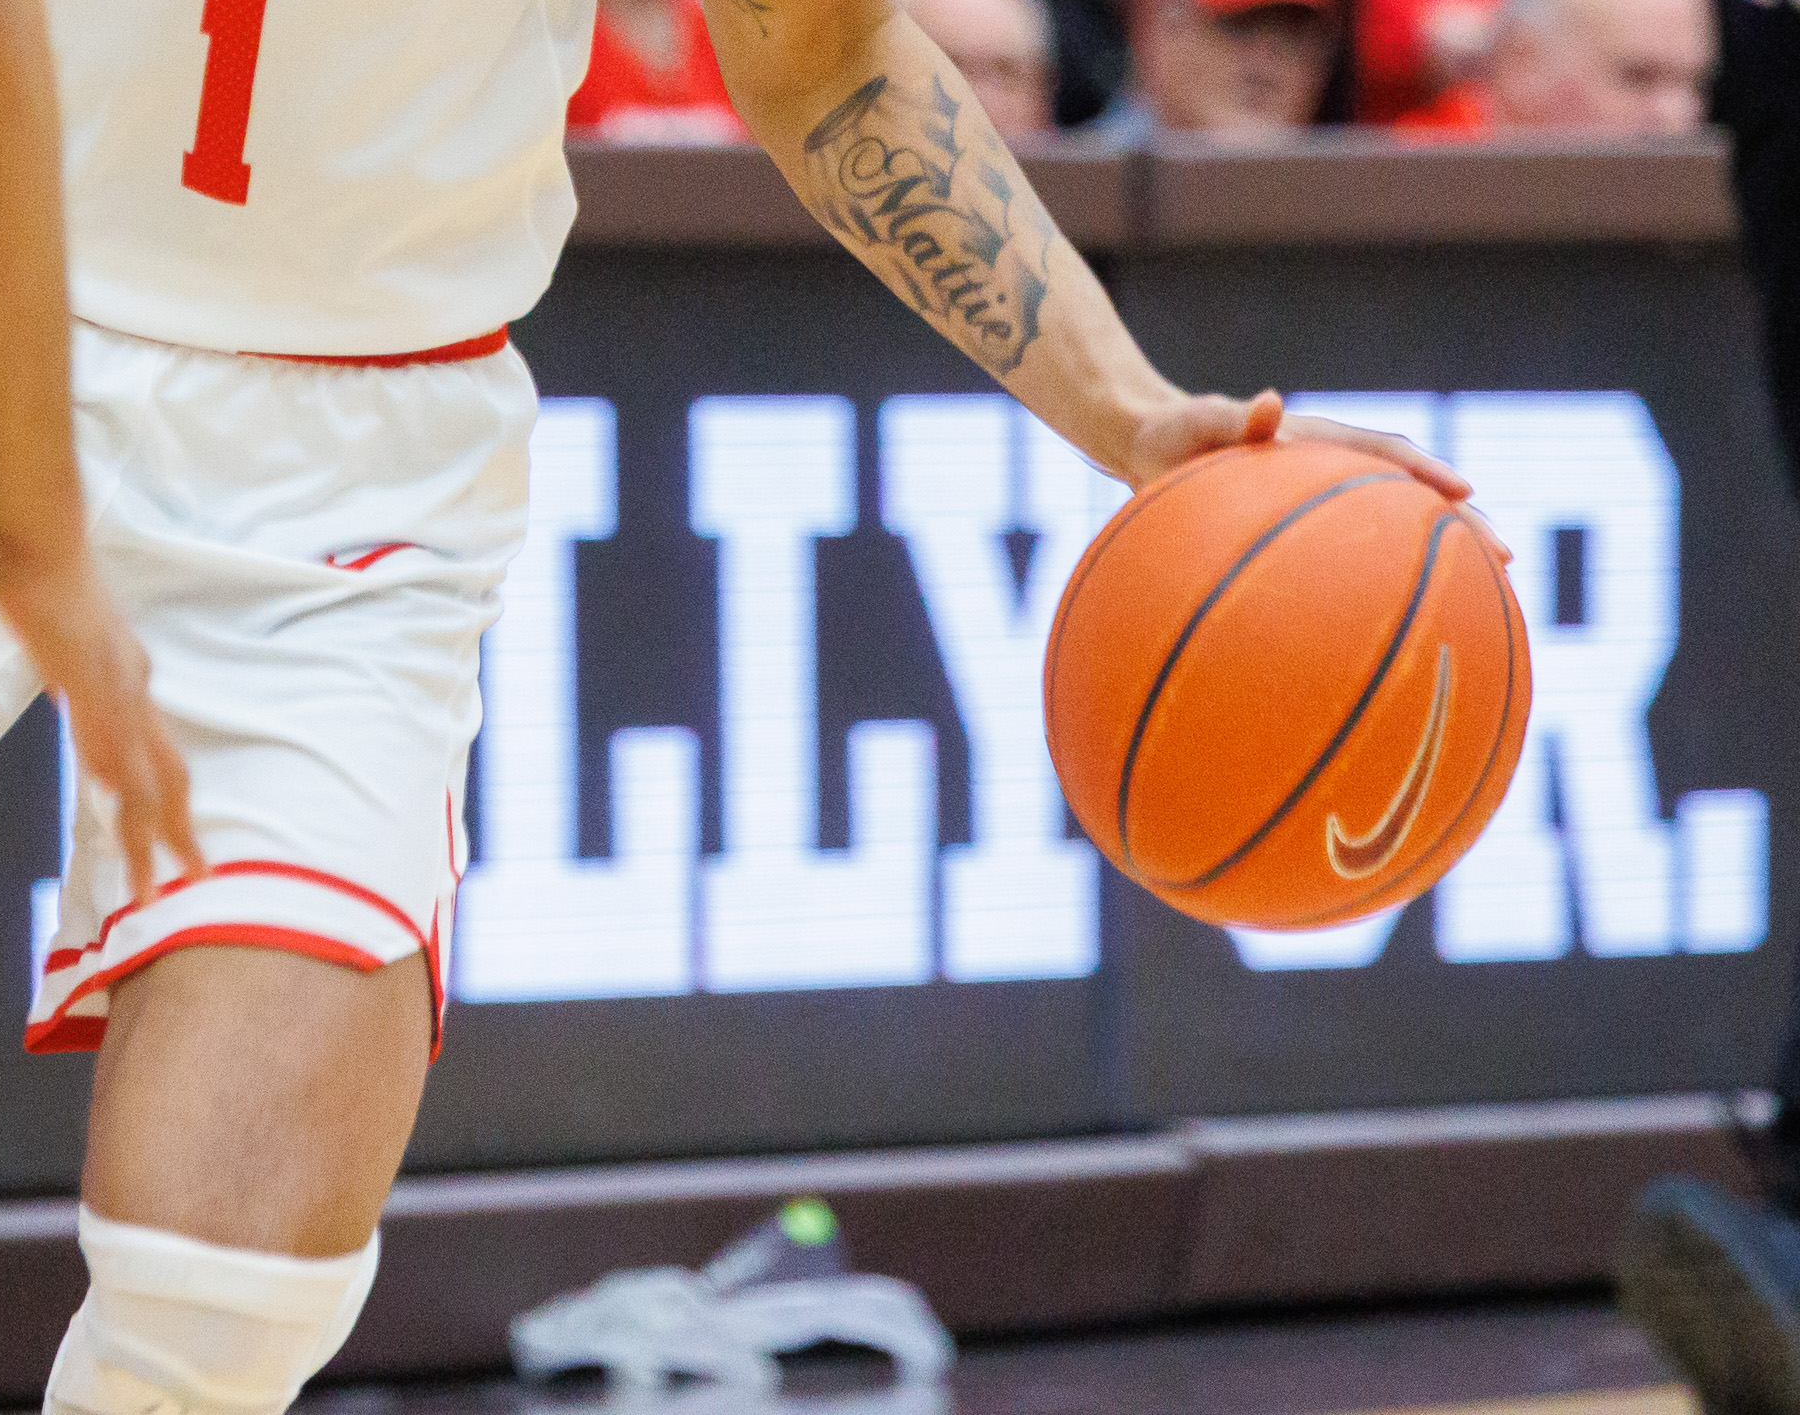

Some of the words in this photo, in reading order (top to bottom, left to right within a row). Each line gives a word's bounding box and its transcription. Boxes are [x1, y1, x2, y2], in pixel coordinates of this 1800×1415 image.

[838, 137, 1013, 342] Mattie
[31, 391, 1132, 1004] LLY
[1222, 389, 1768, 972] R.
